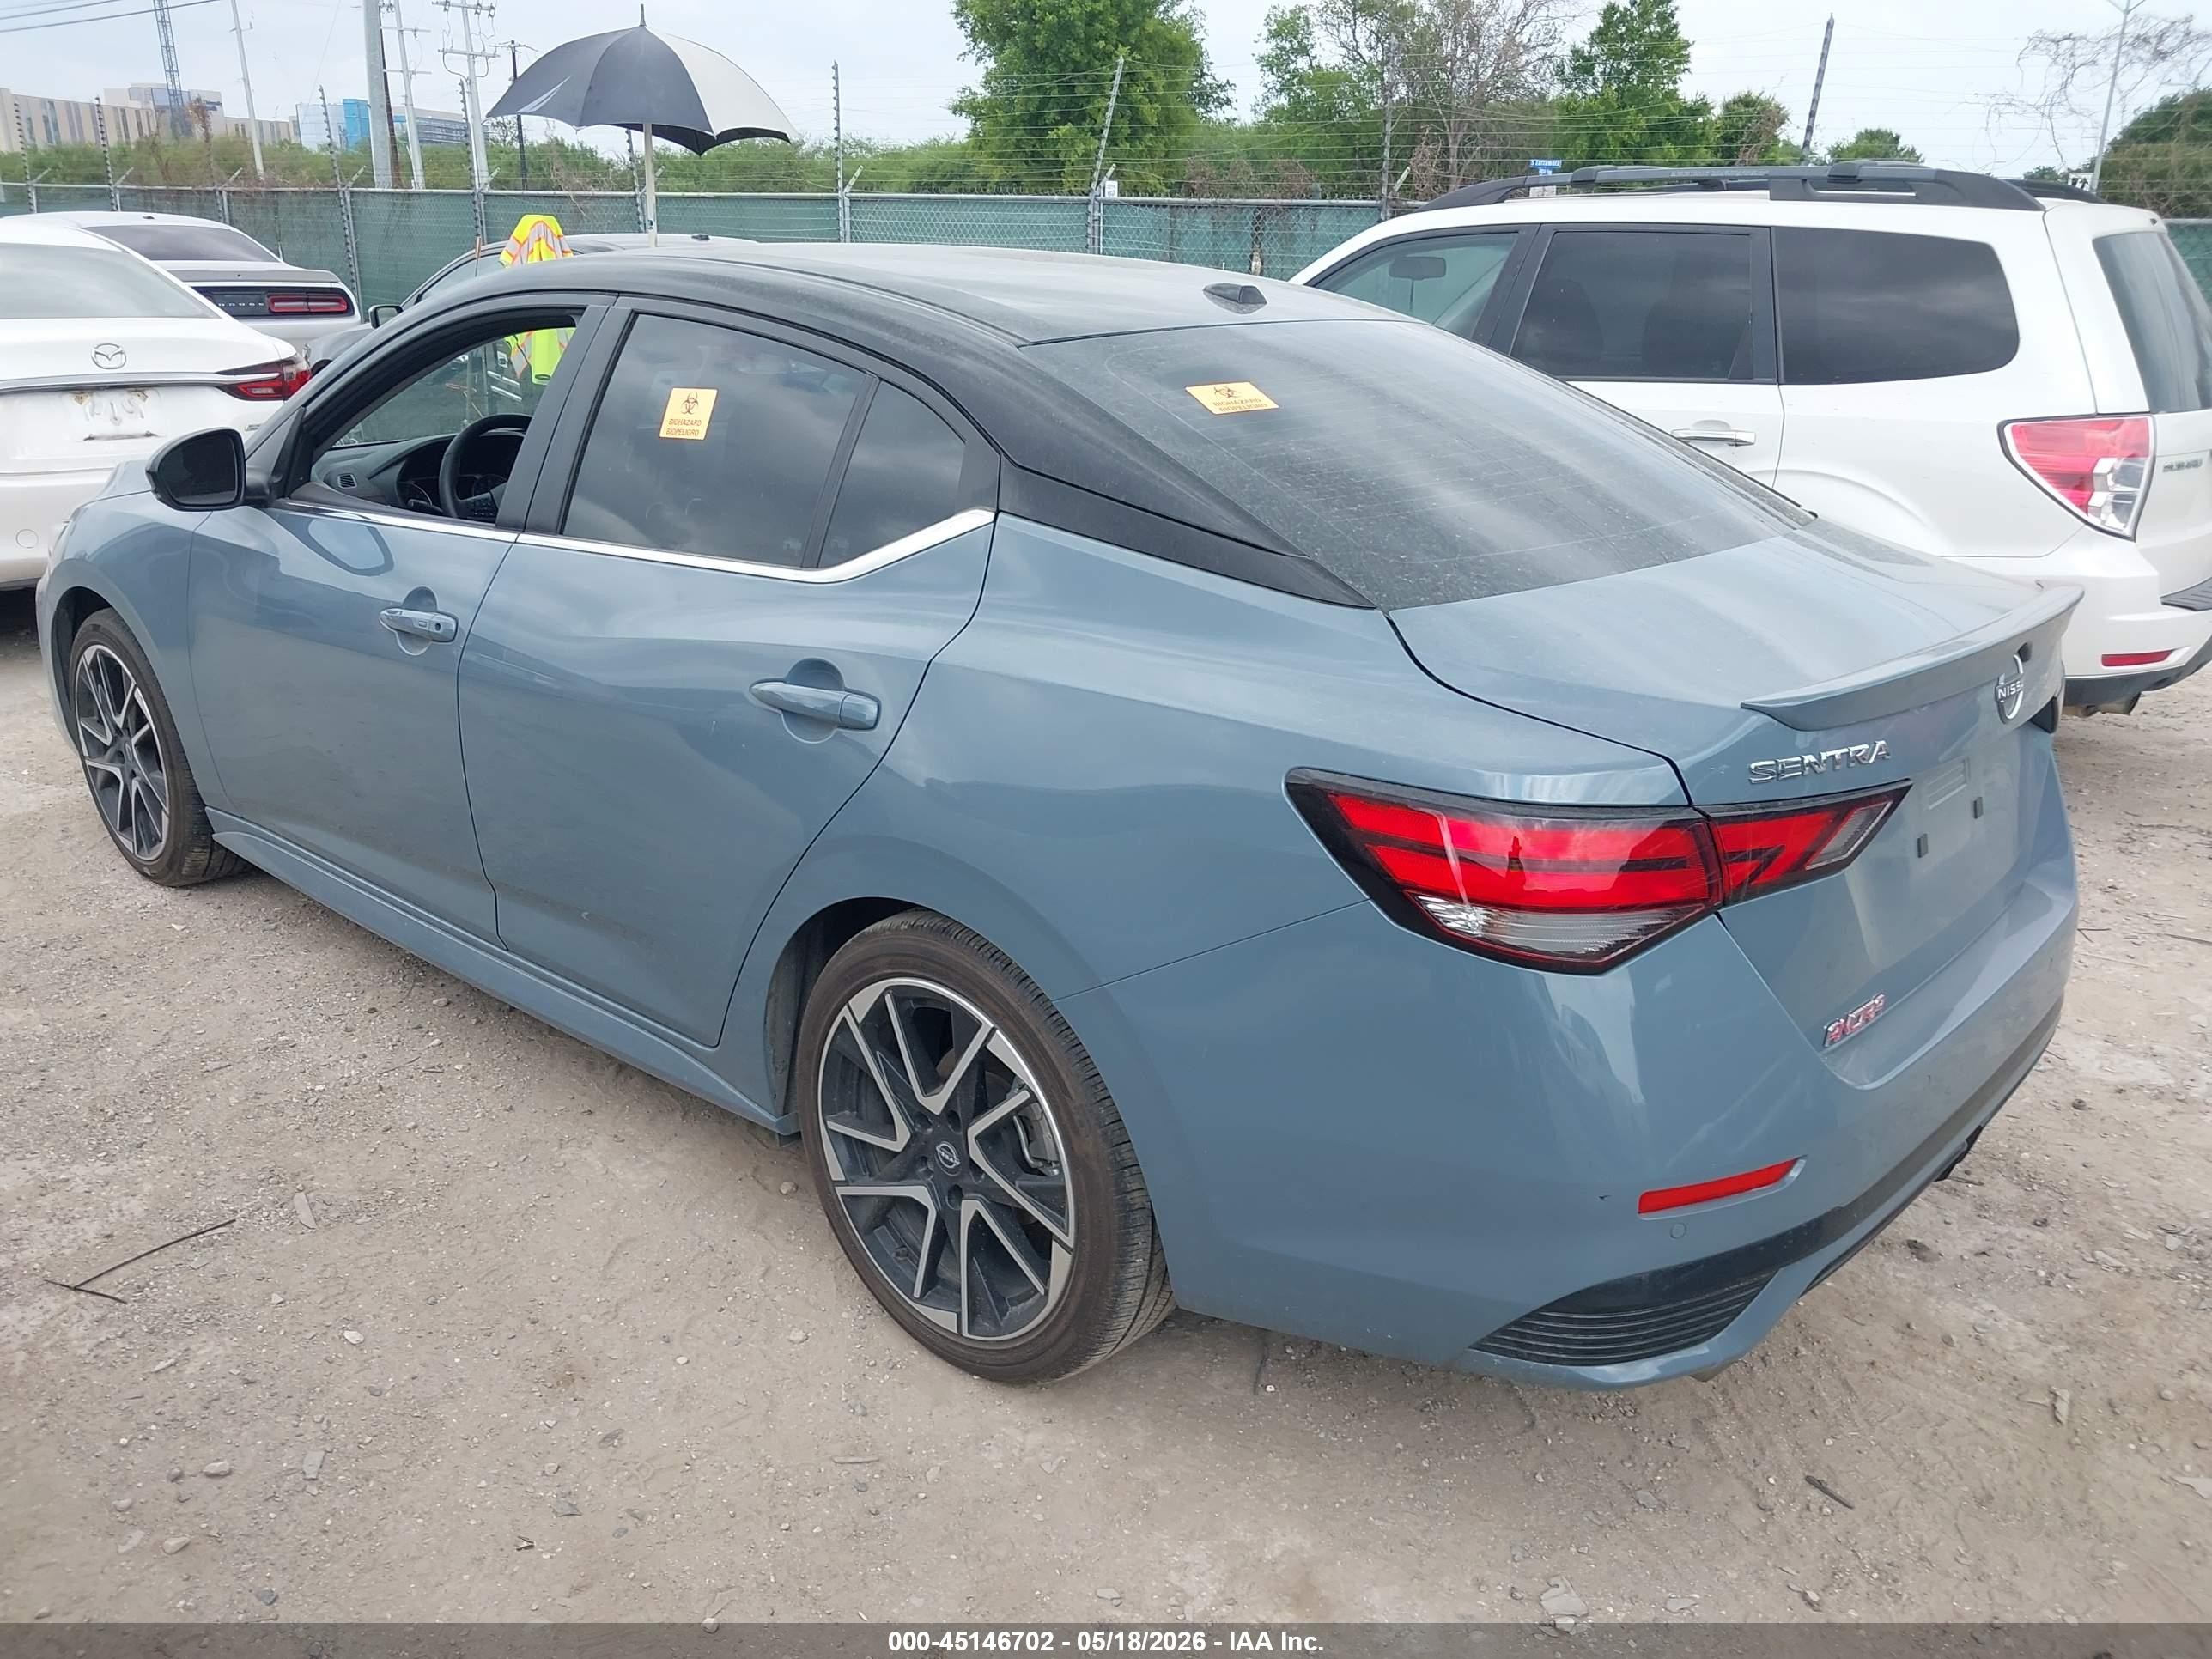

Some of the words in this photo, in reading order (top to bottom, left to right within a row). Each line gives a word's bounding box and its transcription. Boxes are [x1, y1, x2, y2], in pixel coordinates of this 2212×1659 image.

[668, 418, 702, 427] BIOHAZARD
[1997, 679, 2024, 700] NISS
[1748, 739, 1892, 784] SENTRA
